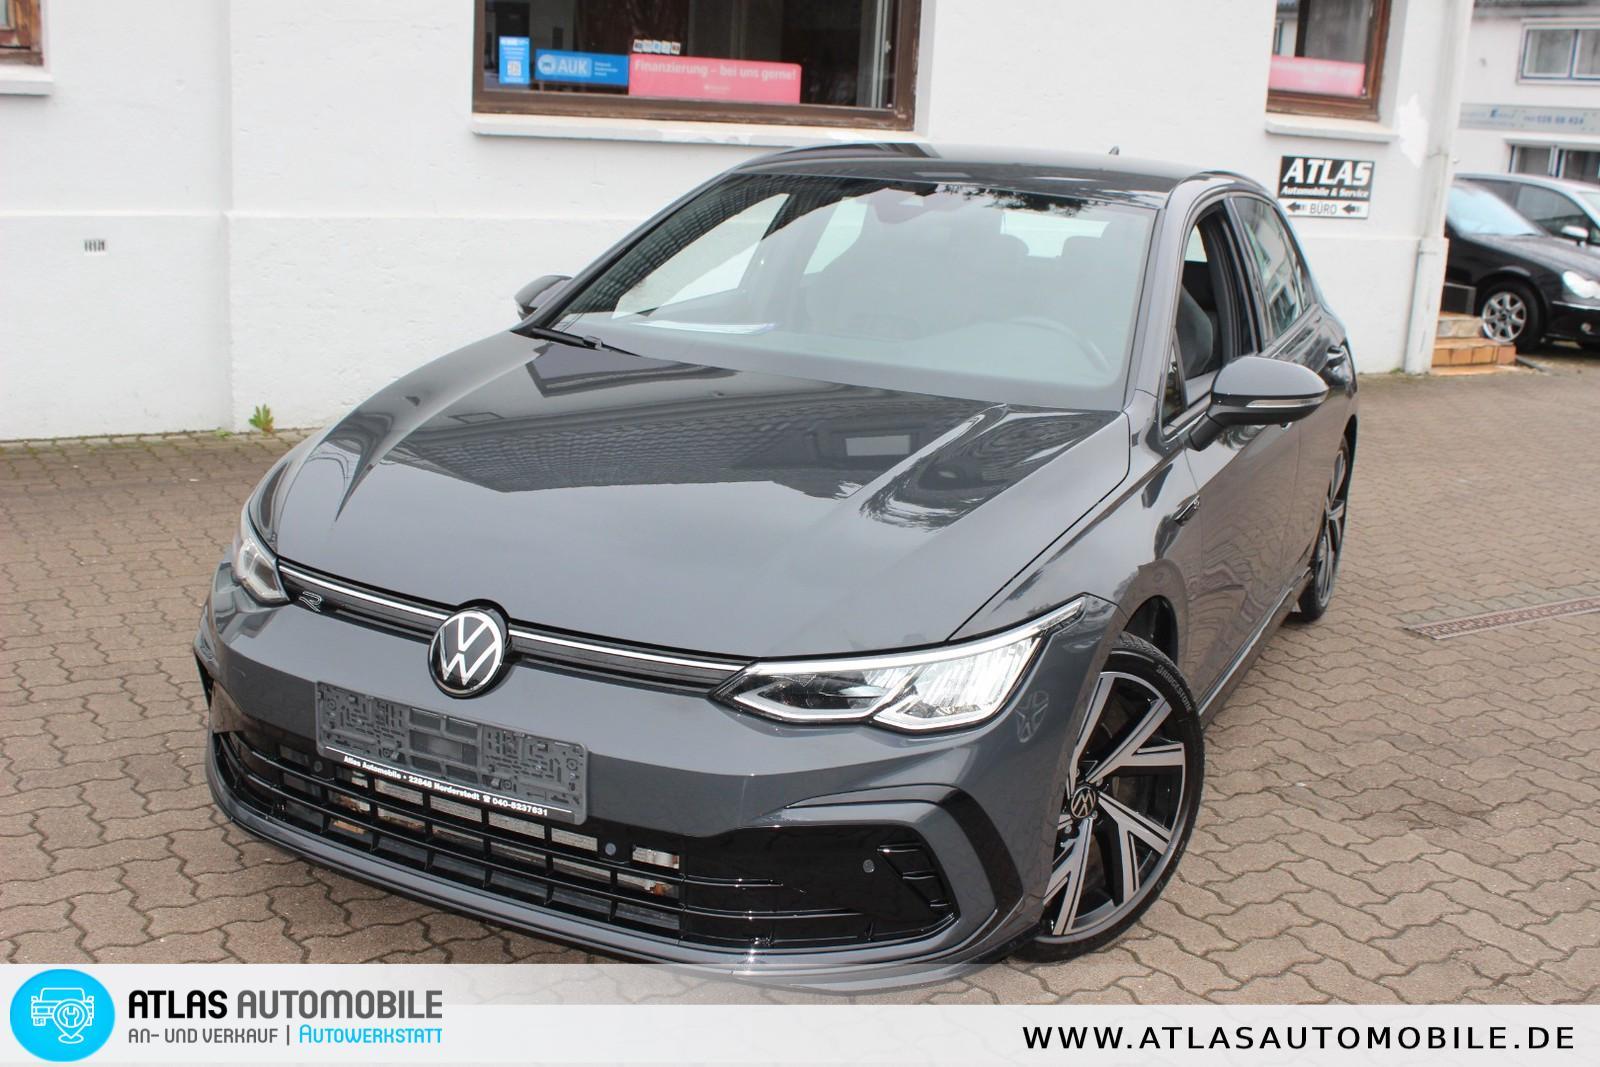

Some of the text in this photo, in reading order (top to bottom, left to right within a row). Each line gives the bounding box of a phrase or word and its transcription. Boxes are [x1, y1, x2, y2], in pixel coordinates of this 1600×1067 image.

[558, 57, 588, 75] AUK
[634, 59, 708, 78] Finanzierung
[720, 64, 737, 77] bei
[740, 67, 759, 78] uns
[761, 68, 797, 81] gerne!
[1282, 158, 1373, 186] ATLAS
[1280, 186, 1330, 197] Automobile
[1338, 188, 1369, 199] Service
[1309, 201, 1337, 215] BÜRO
[343, 755, 361, 767] Atlas
[362, 761, 402, 780] Automobile
[433, 782, 480, 801] Norderstedt
